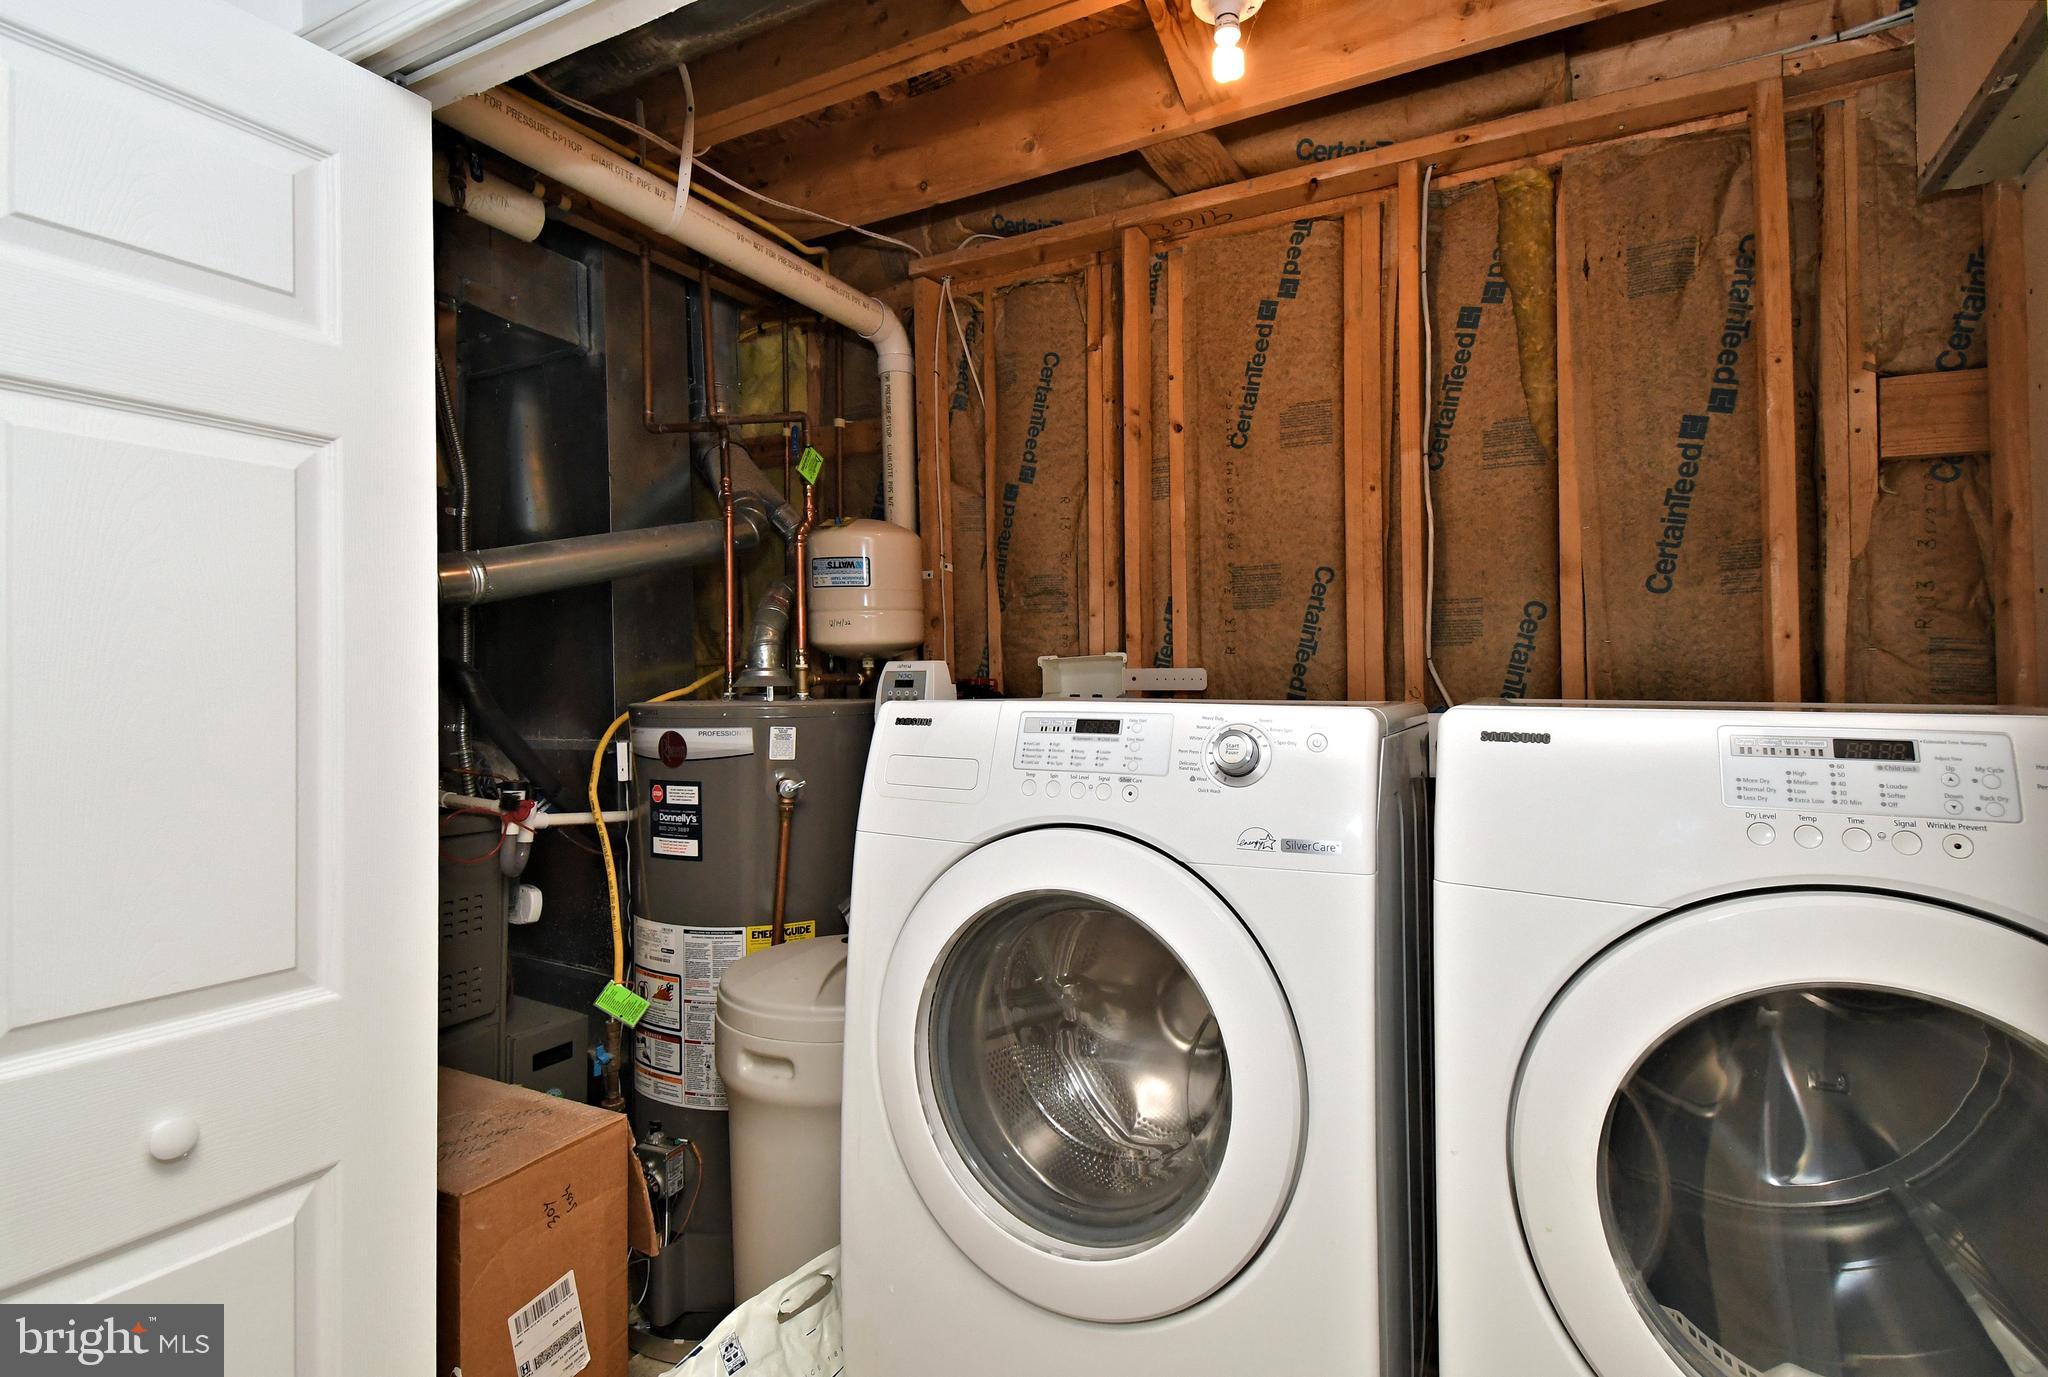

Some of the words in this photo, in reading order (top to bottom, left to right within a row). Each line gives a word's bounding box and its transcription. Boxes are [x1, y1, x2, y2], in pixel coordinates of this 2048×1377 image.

[505, 106, 550, 137] PRESSURE
[1230, 324, 1273, 450] CertainTeed
[1429, 332, 1476, 472] CertainTeed
[1022, 352, 1060, 464] CertainTeed
[1646, 443, 1705, 595] CertainTeed
[827, 560, 856, 570] WATTS
[1289, 566, 1335, 693] CertainTeed
[895, 717, 933, 727] SAMSUNG
[1480, 731, 1551, 744] SAMSUNG
[1945, 765, 1956, 773] Up
[659, 813, 698, 825] Donnelly's
[1745, 812, 1757, 821] Dry
[1758, 812, 1777, 820] Level
[1798, 815, 1818, 824] Temp
[1847, 817, 1865, 825] Time
[1893, 819, 1917, 829] Signal
[1926, 821, 1956, 830] Wrinkle
[1957, 823, 1988, 832] Prevent
